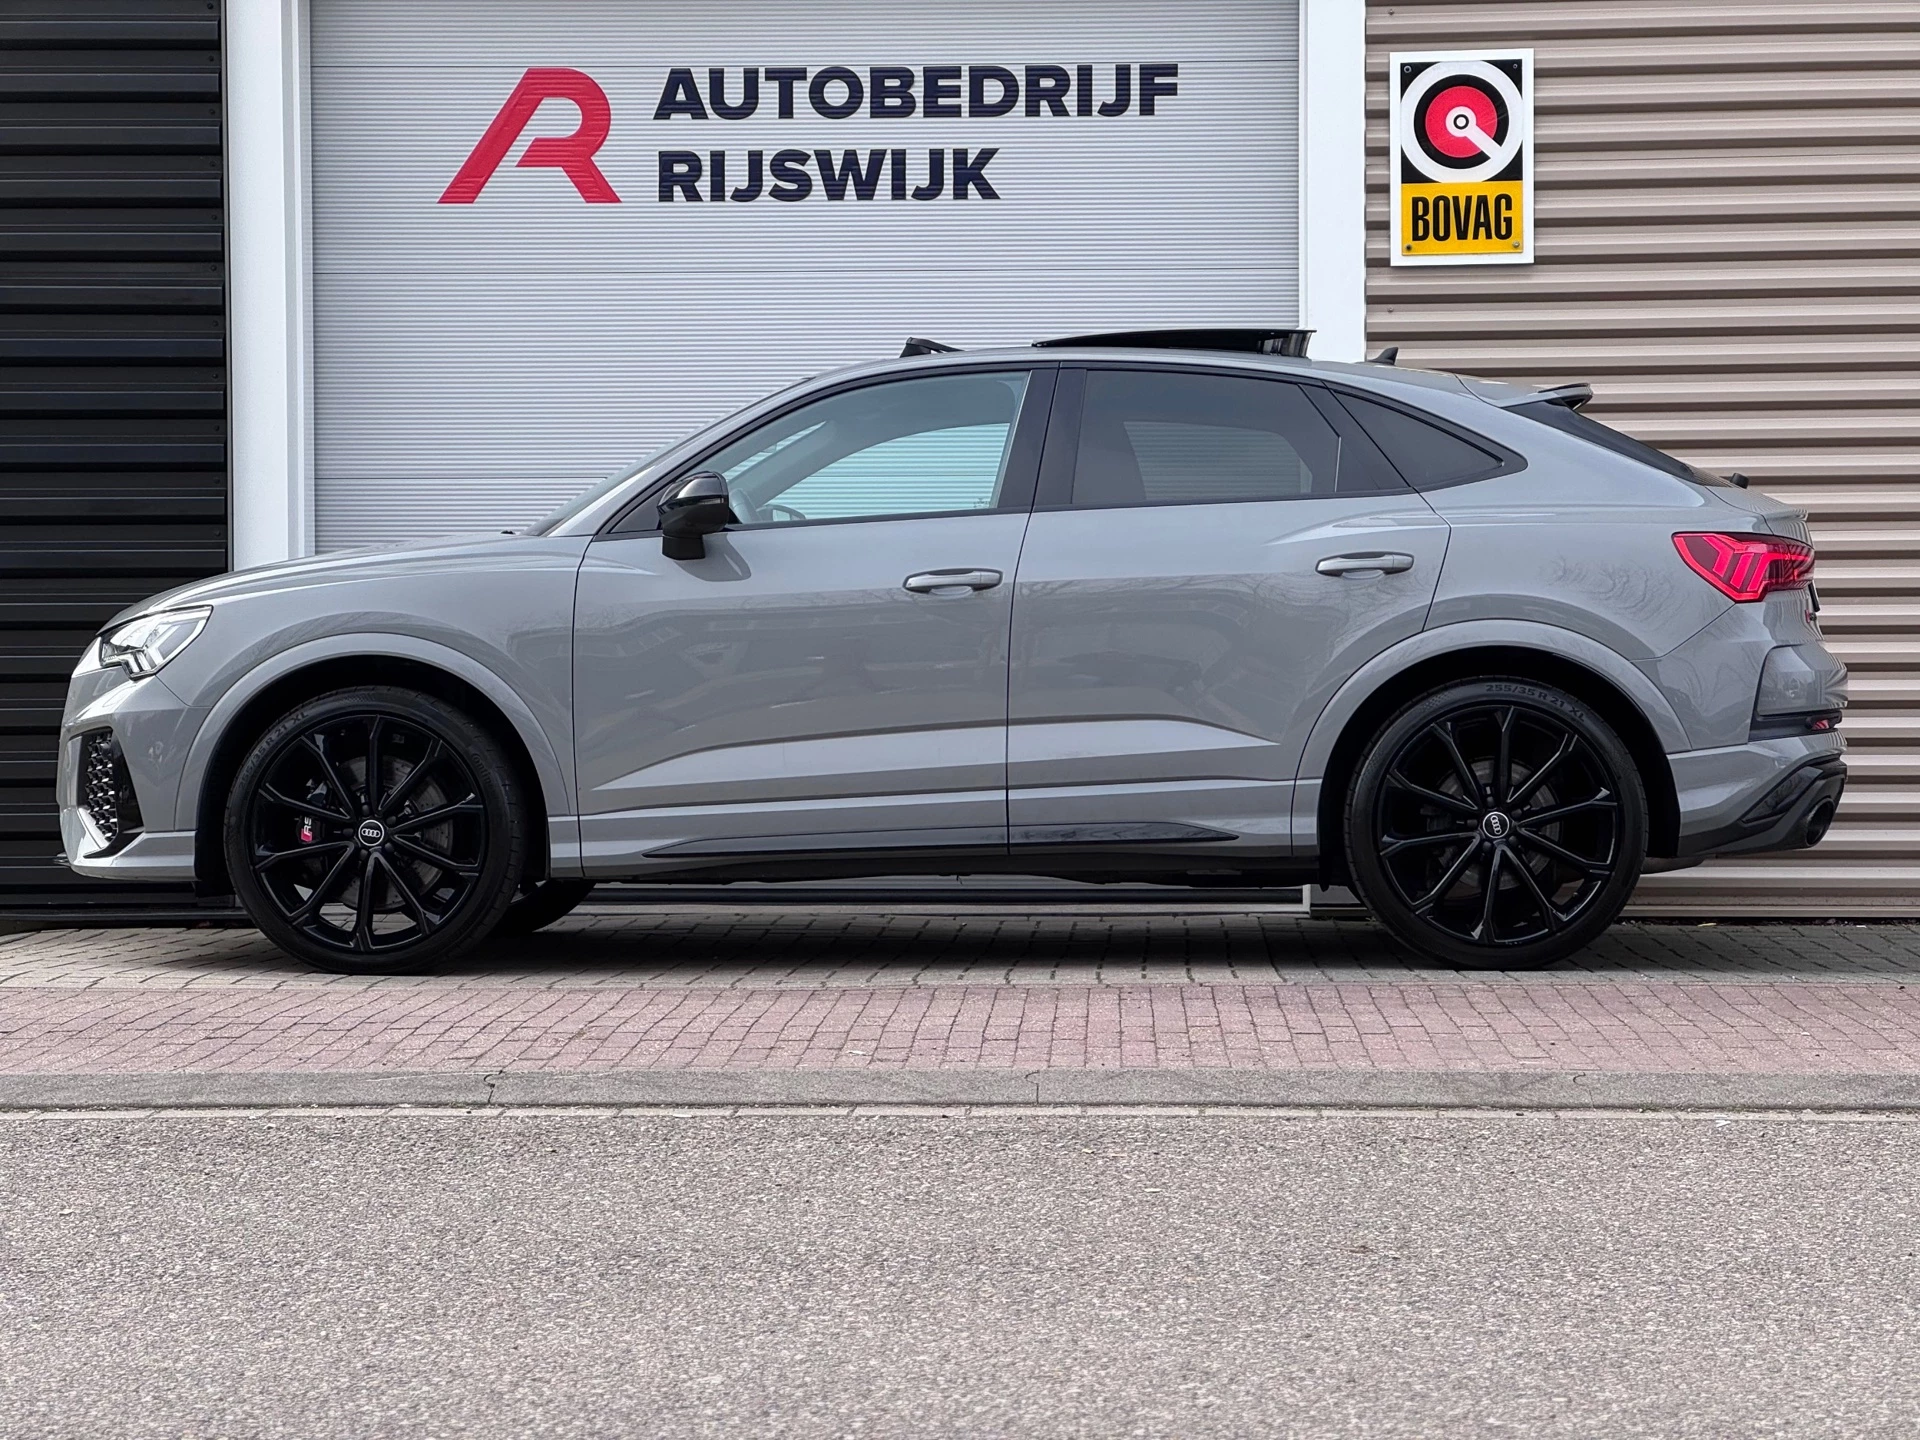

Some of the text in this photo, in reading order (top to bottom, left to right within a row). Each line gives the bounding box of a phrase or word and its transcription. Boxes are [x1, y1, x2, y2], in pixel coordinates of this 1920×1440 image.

[653, 63, 1179, 120] AUTOBEDRIJF
[658, 148, 1001, 203] RIJSWIJK
[1411, 193, 1513, 242] BOVAG
[1485, 684, 1586, 722] 255/35 R 21 XL
[302, 816, 313, 838] RS
